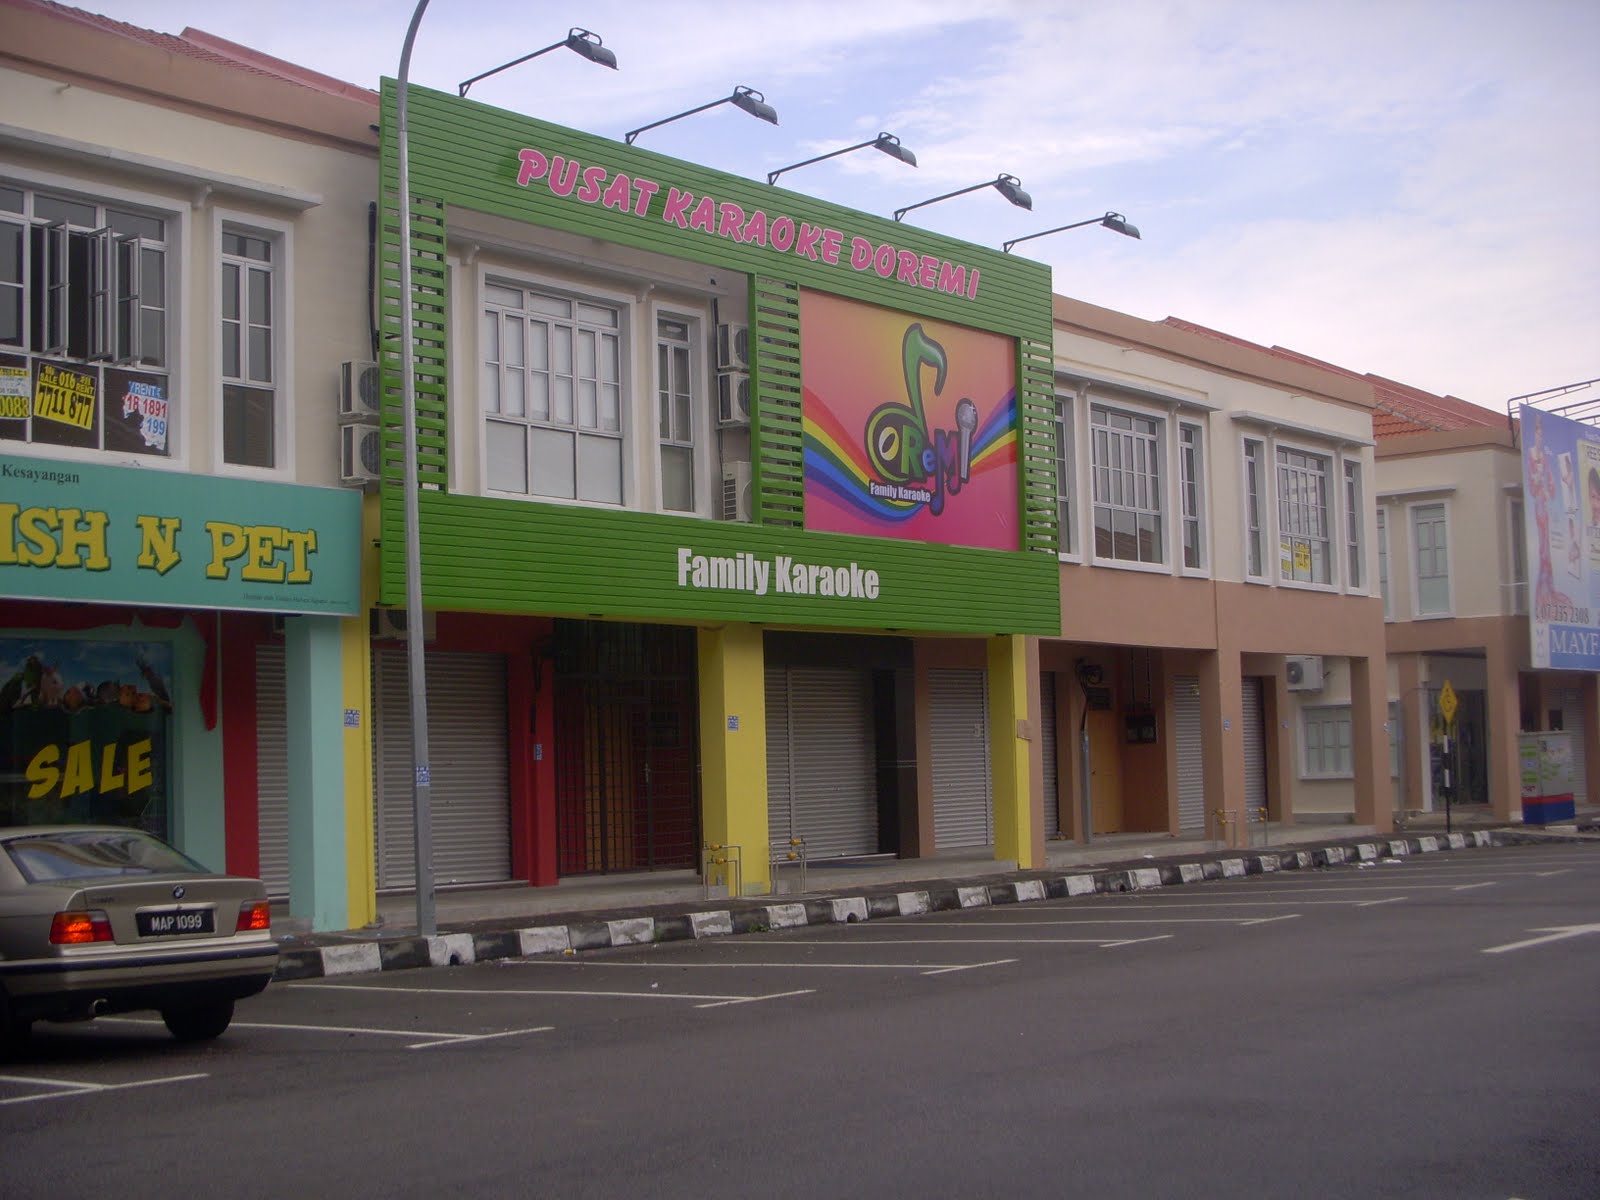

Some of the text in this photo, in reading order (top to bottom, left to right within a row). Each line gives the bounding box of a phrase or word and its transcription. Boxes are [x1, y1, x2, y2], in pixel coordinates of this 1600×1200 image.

[516, 147, 980, 300] PUSAT KARAOKE DOREMI
[40, 373, 58, 385] SALE
[59, 371, 76, 389] 016
[76, 383, 94, 395] RENT
[39, 385, 67, 416] 7711
[69, 392, 92, 426] 877
[143, 398, 167, 418] 1891
[2, 463, 80, 485] Kesayangan
[870, 482, 931, 503] Family Karaoke
[136, 514, 182, 576] N
[205, 521, 318, 584] PET
[678, 547, 880, 600] Family Karaoke
[1551, 629, 1600, 656] MAYF
[25, 738, 153, 799] SALE
[151, 913, 202, 931] MAP 1099
